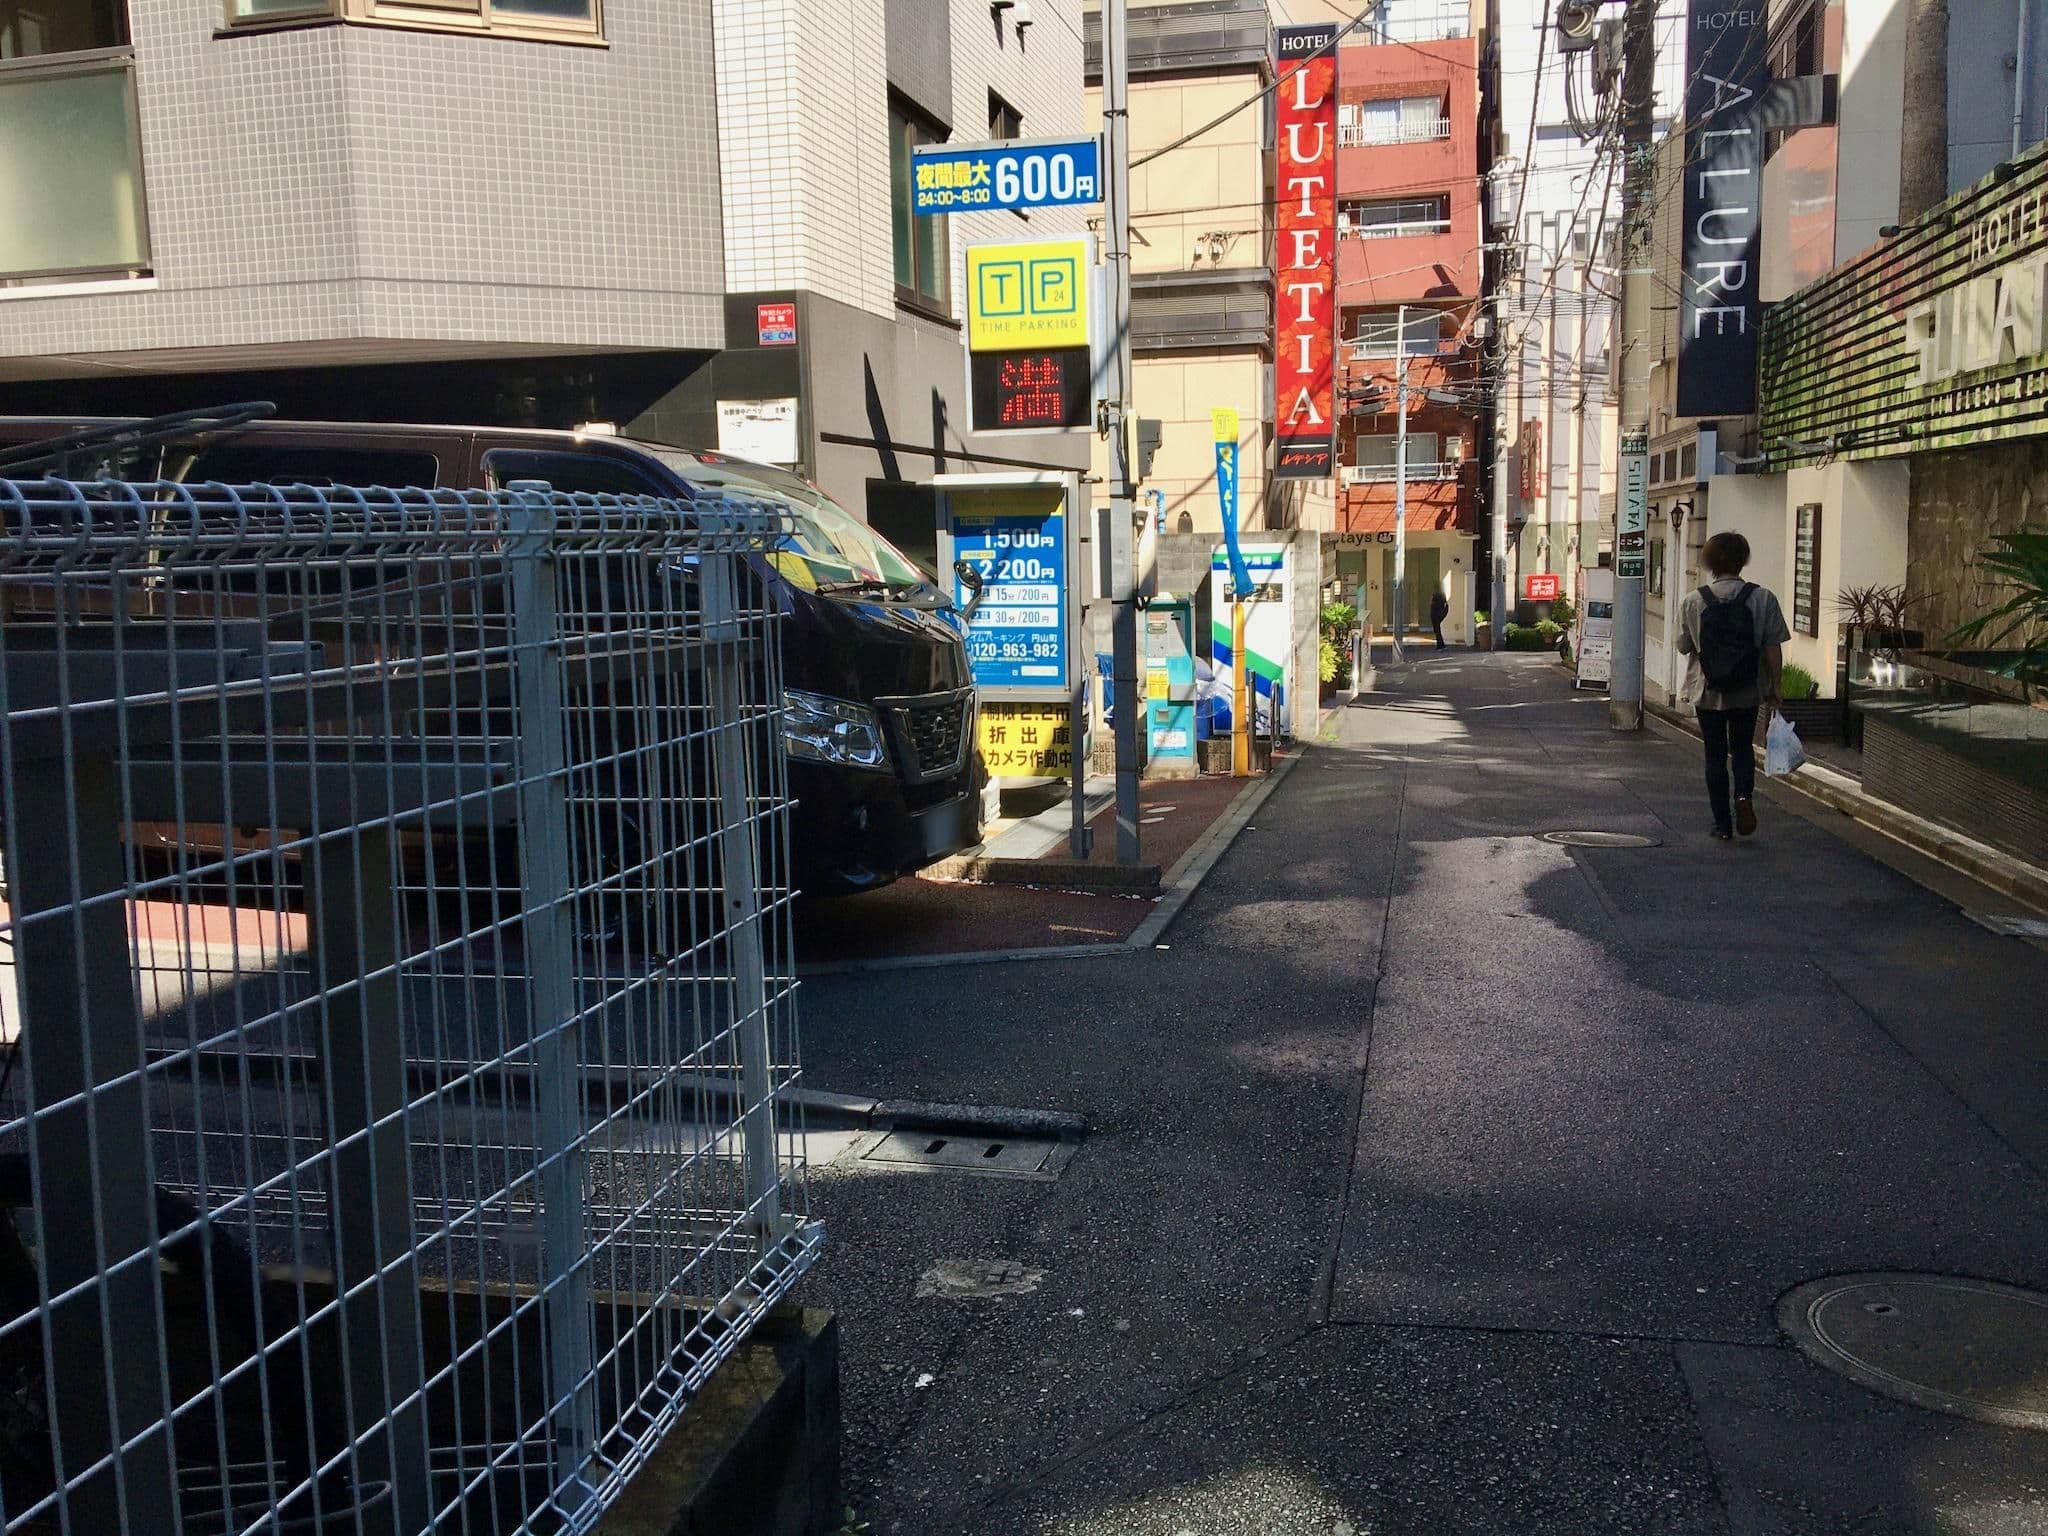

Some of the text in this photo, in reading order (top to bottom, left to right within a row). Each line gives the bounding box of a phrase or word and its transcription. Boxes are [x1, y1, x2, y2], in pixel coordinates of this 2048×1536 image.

[1697, 10, 1758, 30] HOTEL
[1281, 32, 1329, 52] HOTEL
[916, 161, 991, 190] 夜間最大
[995, 153, 1094, 203] 600円
[1694, 73, 1753, 339] ALLURE
[1971, 191, 2045, 265] HOTEL
[1285, 69, 1327, 425] LUTETIA
[1053, 289, 1065, 302] 24
[981, 319, 1078, 333] TIME PARKING
[1001, 356, 1061, 423] 満
[983, 528, 1055, 549] 1,500円
[1335, 532, 1372, 547] tays
[979, 559, 1055, 580] 2,200円
[969, 632, 1058, 643] イムパーキング 円山町
[984, 749, 1072, 769] カメラ作動中
